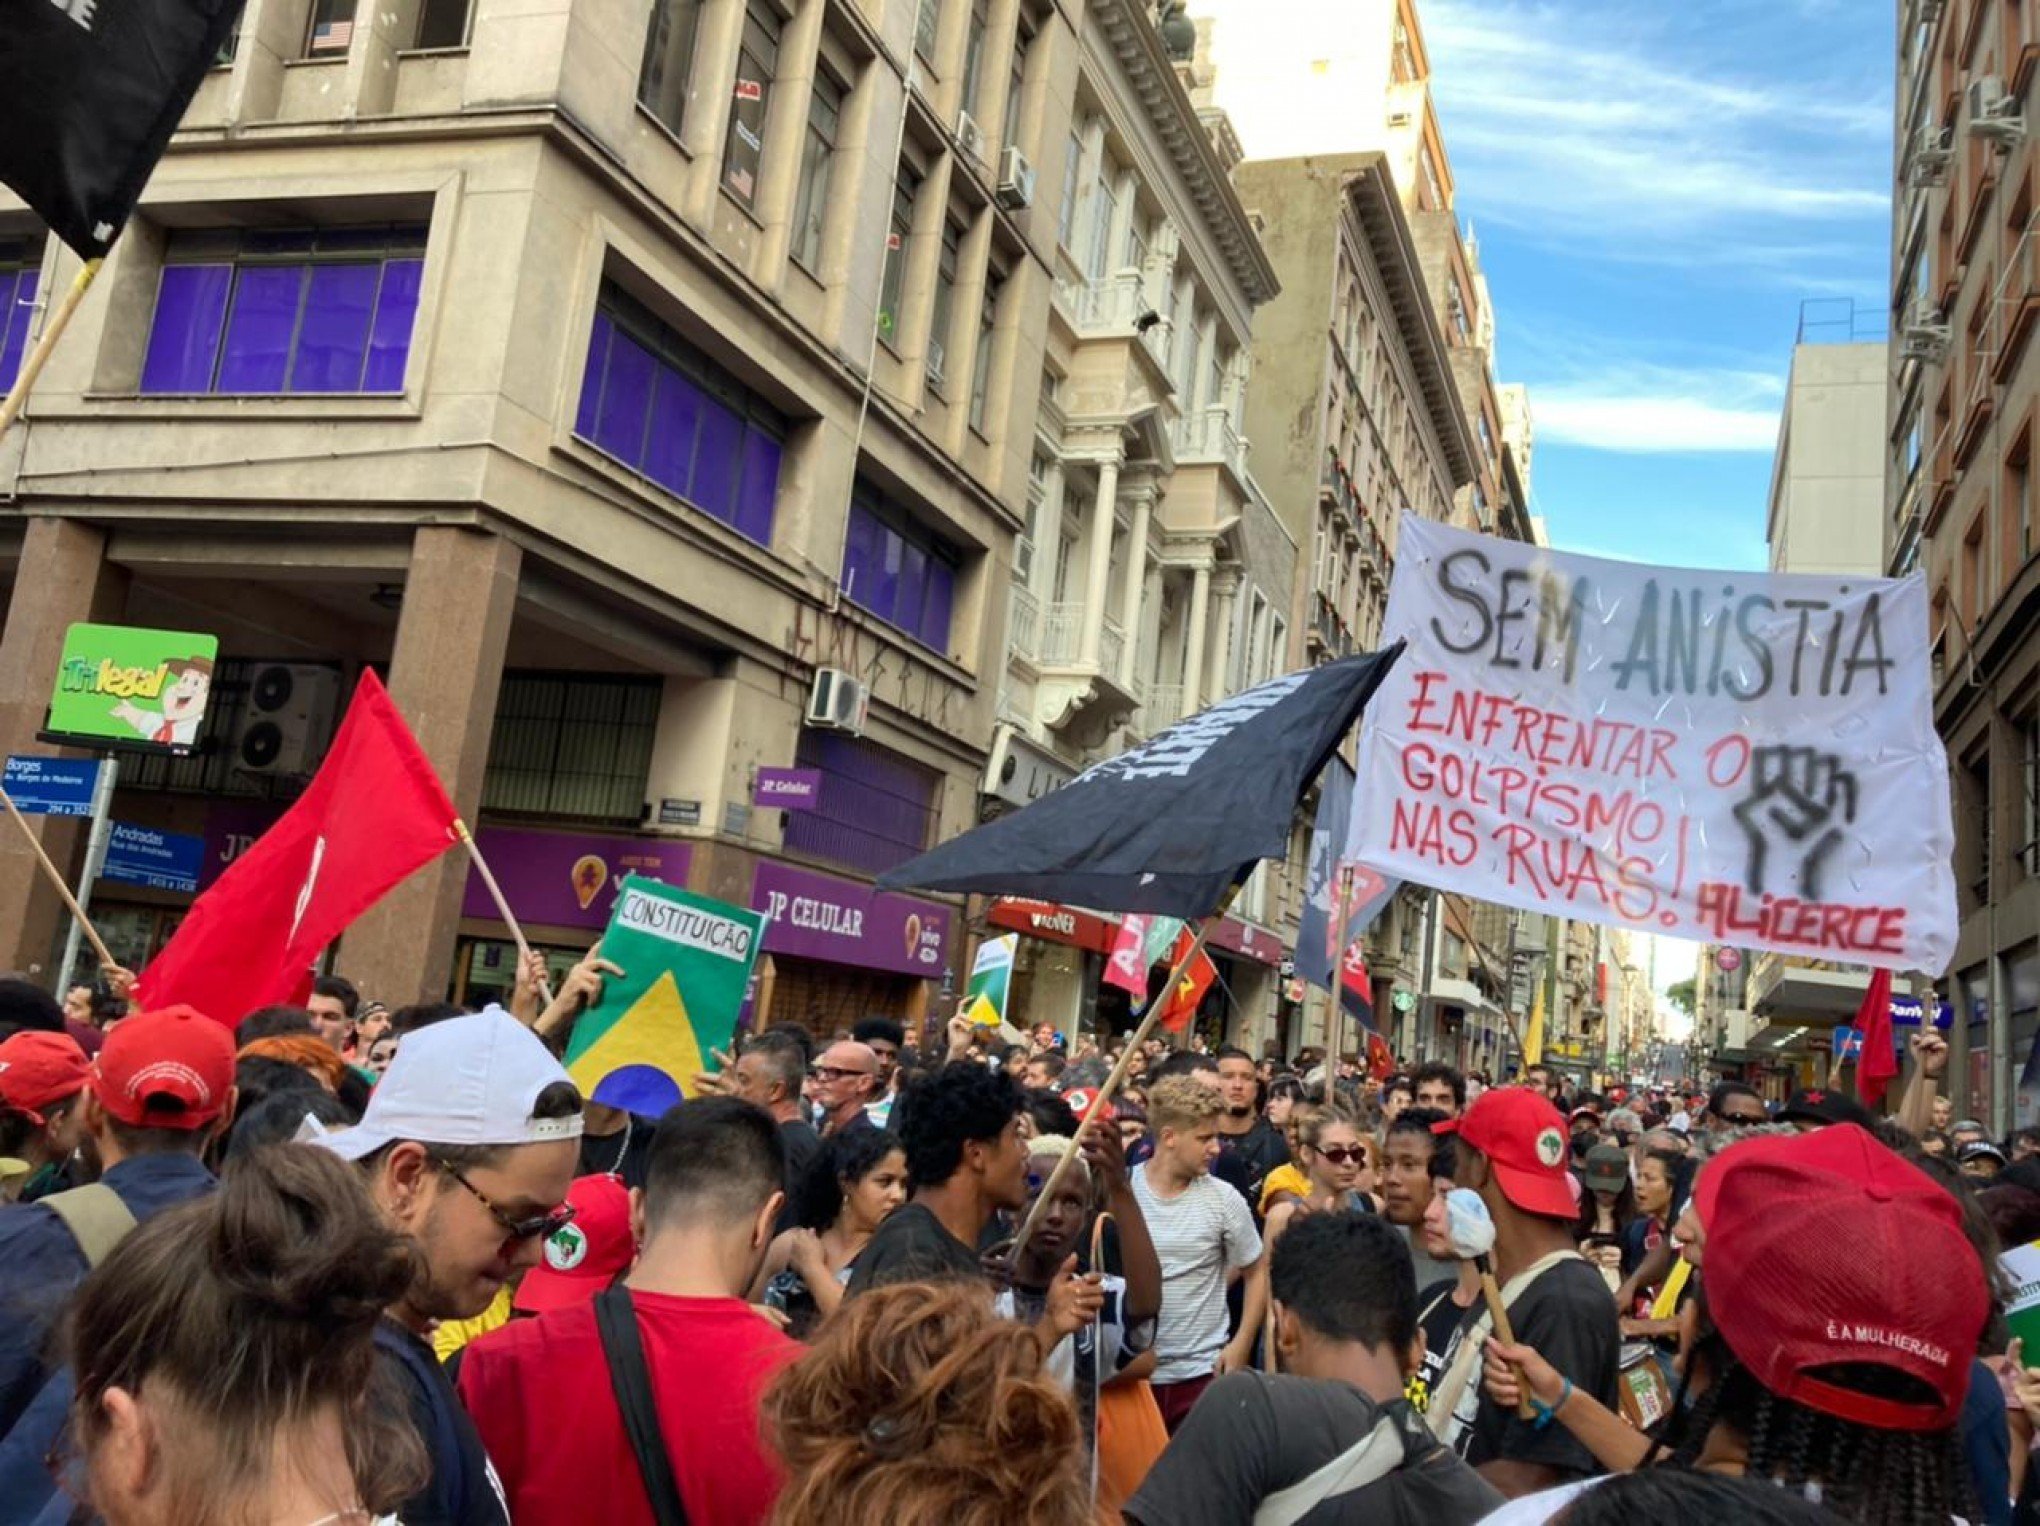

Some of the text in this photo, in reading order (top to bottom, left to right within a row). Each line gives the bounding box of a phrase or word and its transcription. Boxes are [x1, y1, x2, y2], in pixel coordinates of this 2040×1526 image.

[1430, 549, 1589, 685] SEM
[1406, 671, 1678, 780] ENFRENTAR
[1706, 732, 1752, 788] O
[7, 757, 41, 774] Borges
[775, 780, 812, 796] Celular
[114, 825, 164, 845] Andradas
[1390, 798, 1478, 866] NAS
[621, 893, 750, 955] CONSTITUIÇÃO
[766, 891, 864, 938] JP CELULAR
[1827, 1320, 1838, 1339] É
[1840, 1324, 1851, 1339] A
